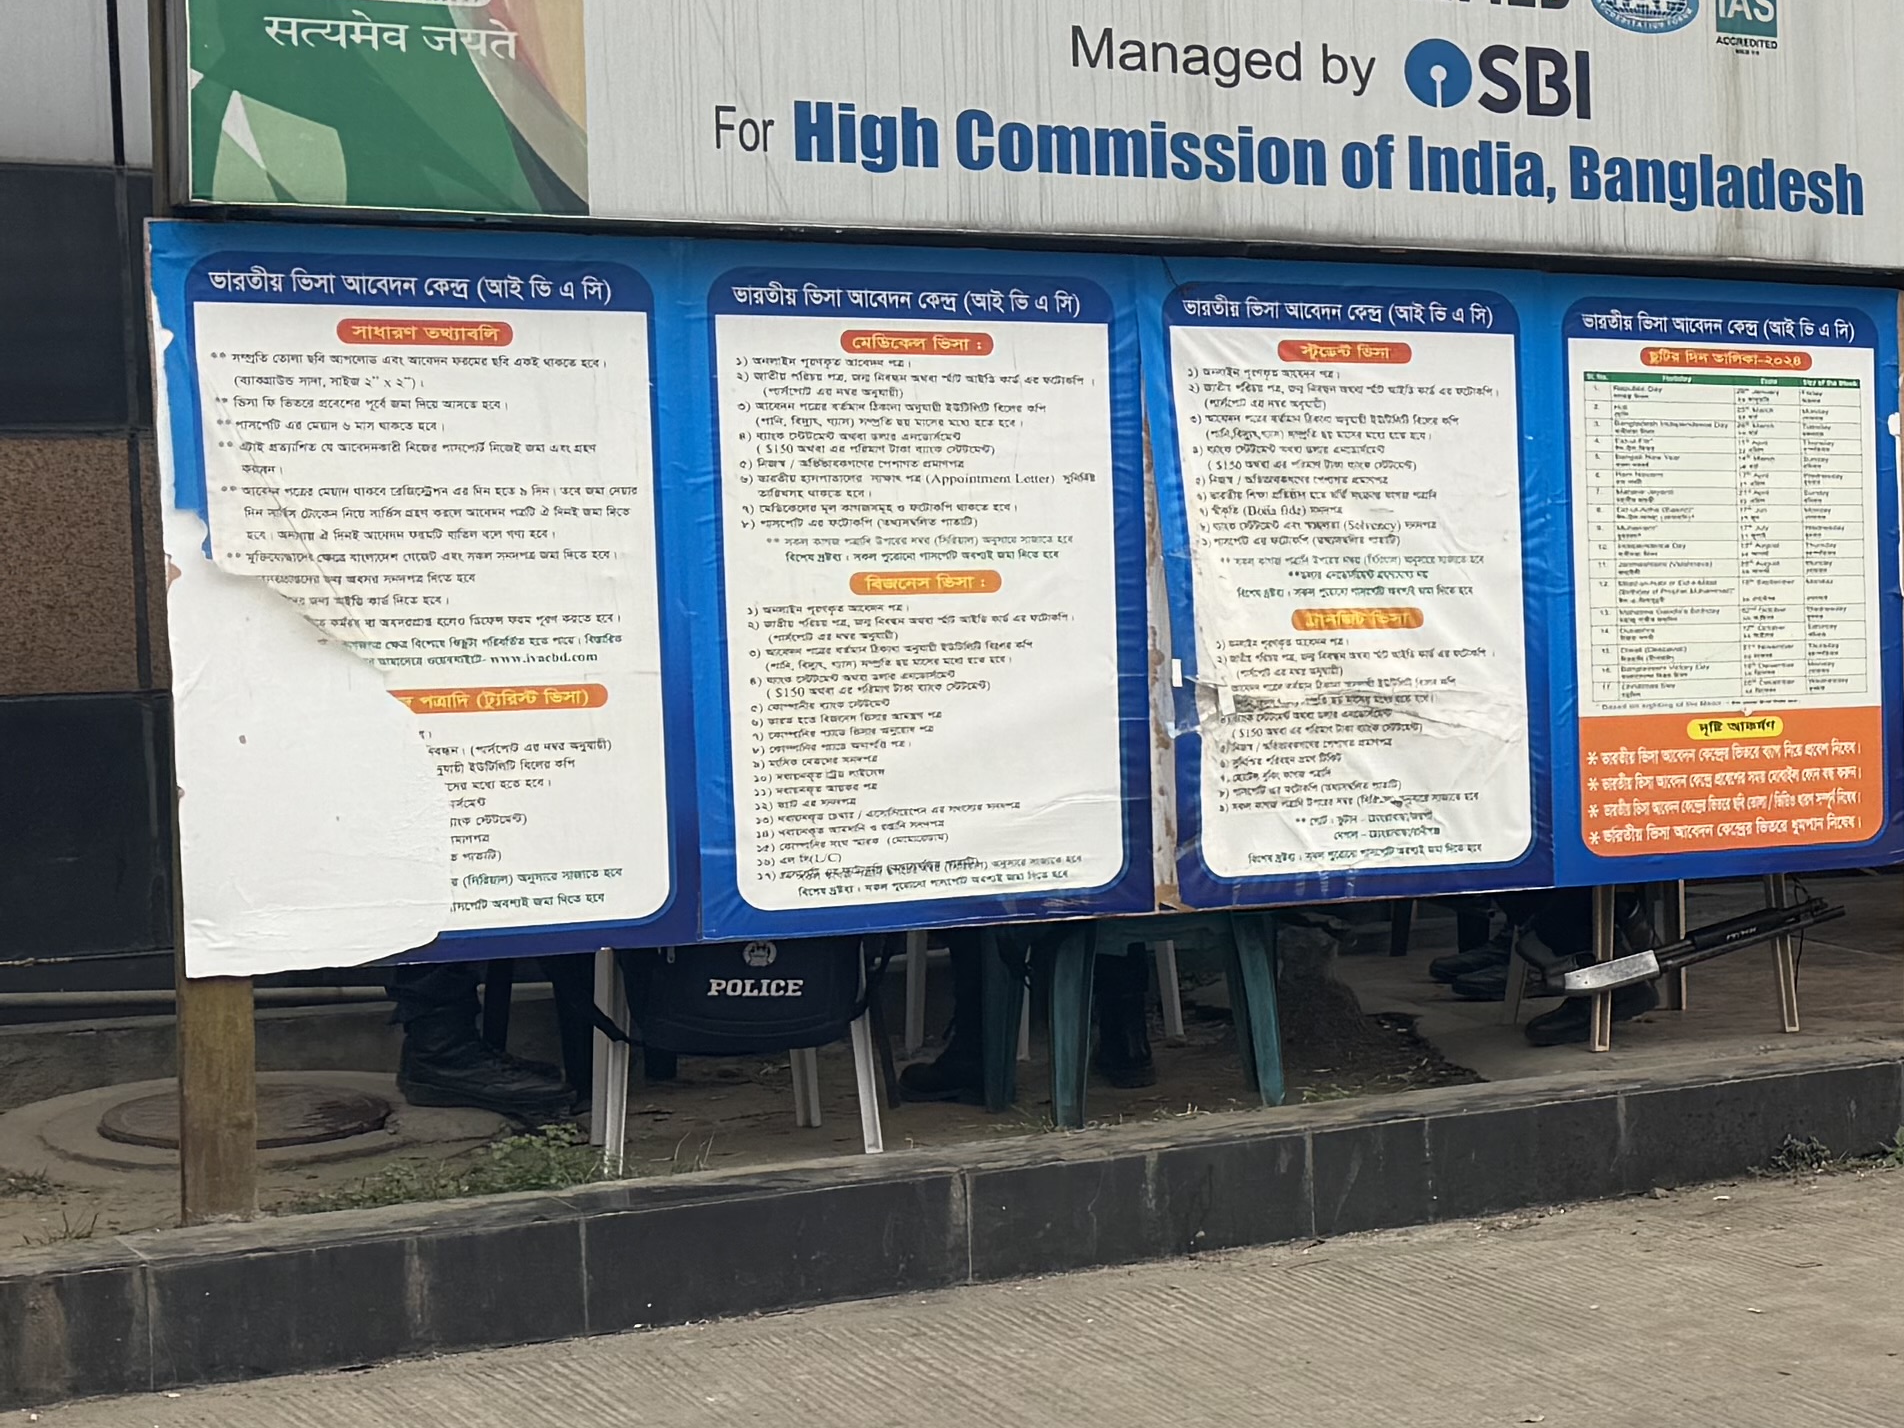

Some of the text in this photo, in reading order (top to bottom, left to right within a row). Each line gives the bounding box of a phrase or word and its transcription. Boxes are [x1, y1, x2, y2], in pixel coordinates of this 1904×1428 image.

[263, 9, 518, 60] सत्यमेव जयते
[1716, 35, 1777, 49] ACCREDITED
[1070, 25, 1592, 120] Managed by SBI
[714, 99, 1864, 216] For High Commission of India, Bangladesh
[208, 266, 285, 292] ভারতীয়
[290, 267, 336, 293] ভিসা
[341, 273, 418, 296] আবেদন
[477, 273, 524, 303] (আই
[529, 274, 553, 299] ভি
[559, 280, 574, 300] এ
[581, 275, 611, 305] সি)
[732, 280, 797, 306] ভারতীয়
[803, 283, 841, 308] ভিসা
[848, 289, 911, 310] আবেদন
[964, 287, 1004, 315] (আই
[1009, 287, 1030, 312] ভি
[1035, 294, 1048, 312] এ
[1054, 289, 1080, 318] সি)
[1183, 294, 1240, 318] ভারতীয়
[1246, 296, 1280, 319] ভিসা
[1285, 302, 1341, 321] আবেদন
[1430, 300, 1447, 322] ভি
[1452, 306, 1464, 323] এ
[352, 325, 417, 341] সাধারণ
[1638, 311, 1667, 332] ভিসা
[1671, 318, 1722, 335] আবেদন
[1819, 322, 1829, 338] এ
[852, 336, 926, 353] মেডিকেল
[932, 336, 970, 353] ভিসা
[1357, 344, 1391, 360] ভিসা
[1685, 348, 1709, 363] দিন
[936, 573, 975, 590] ভিসা
[544, 687, 590, 709] ভিসা)
[1646, 822, 1670, 840] ভিসা
[707, 979, 804, 996] POLICE
